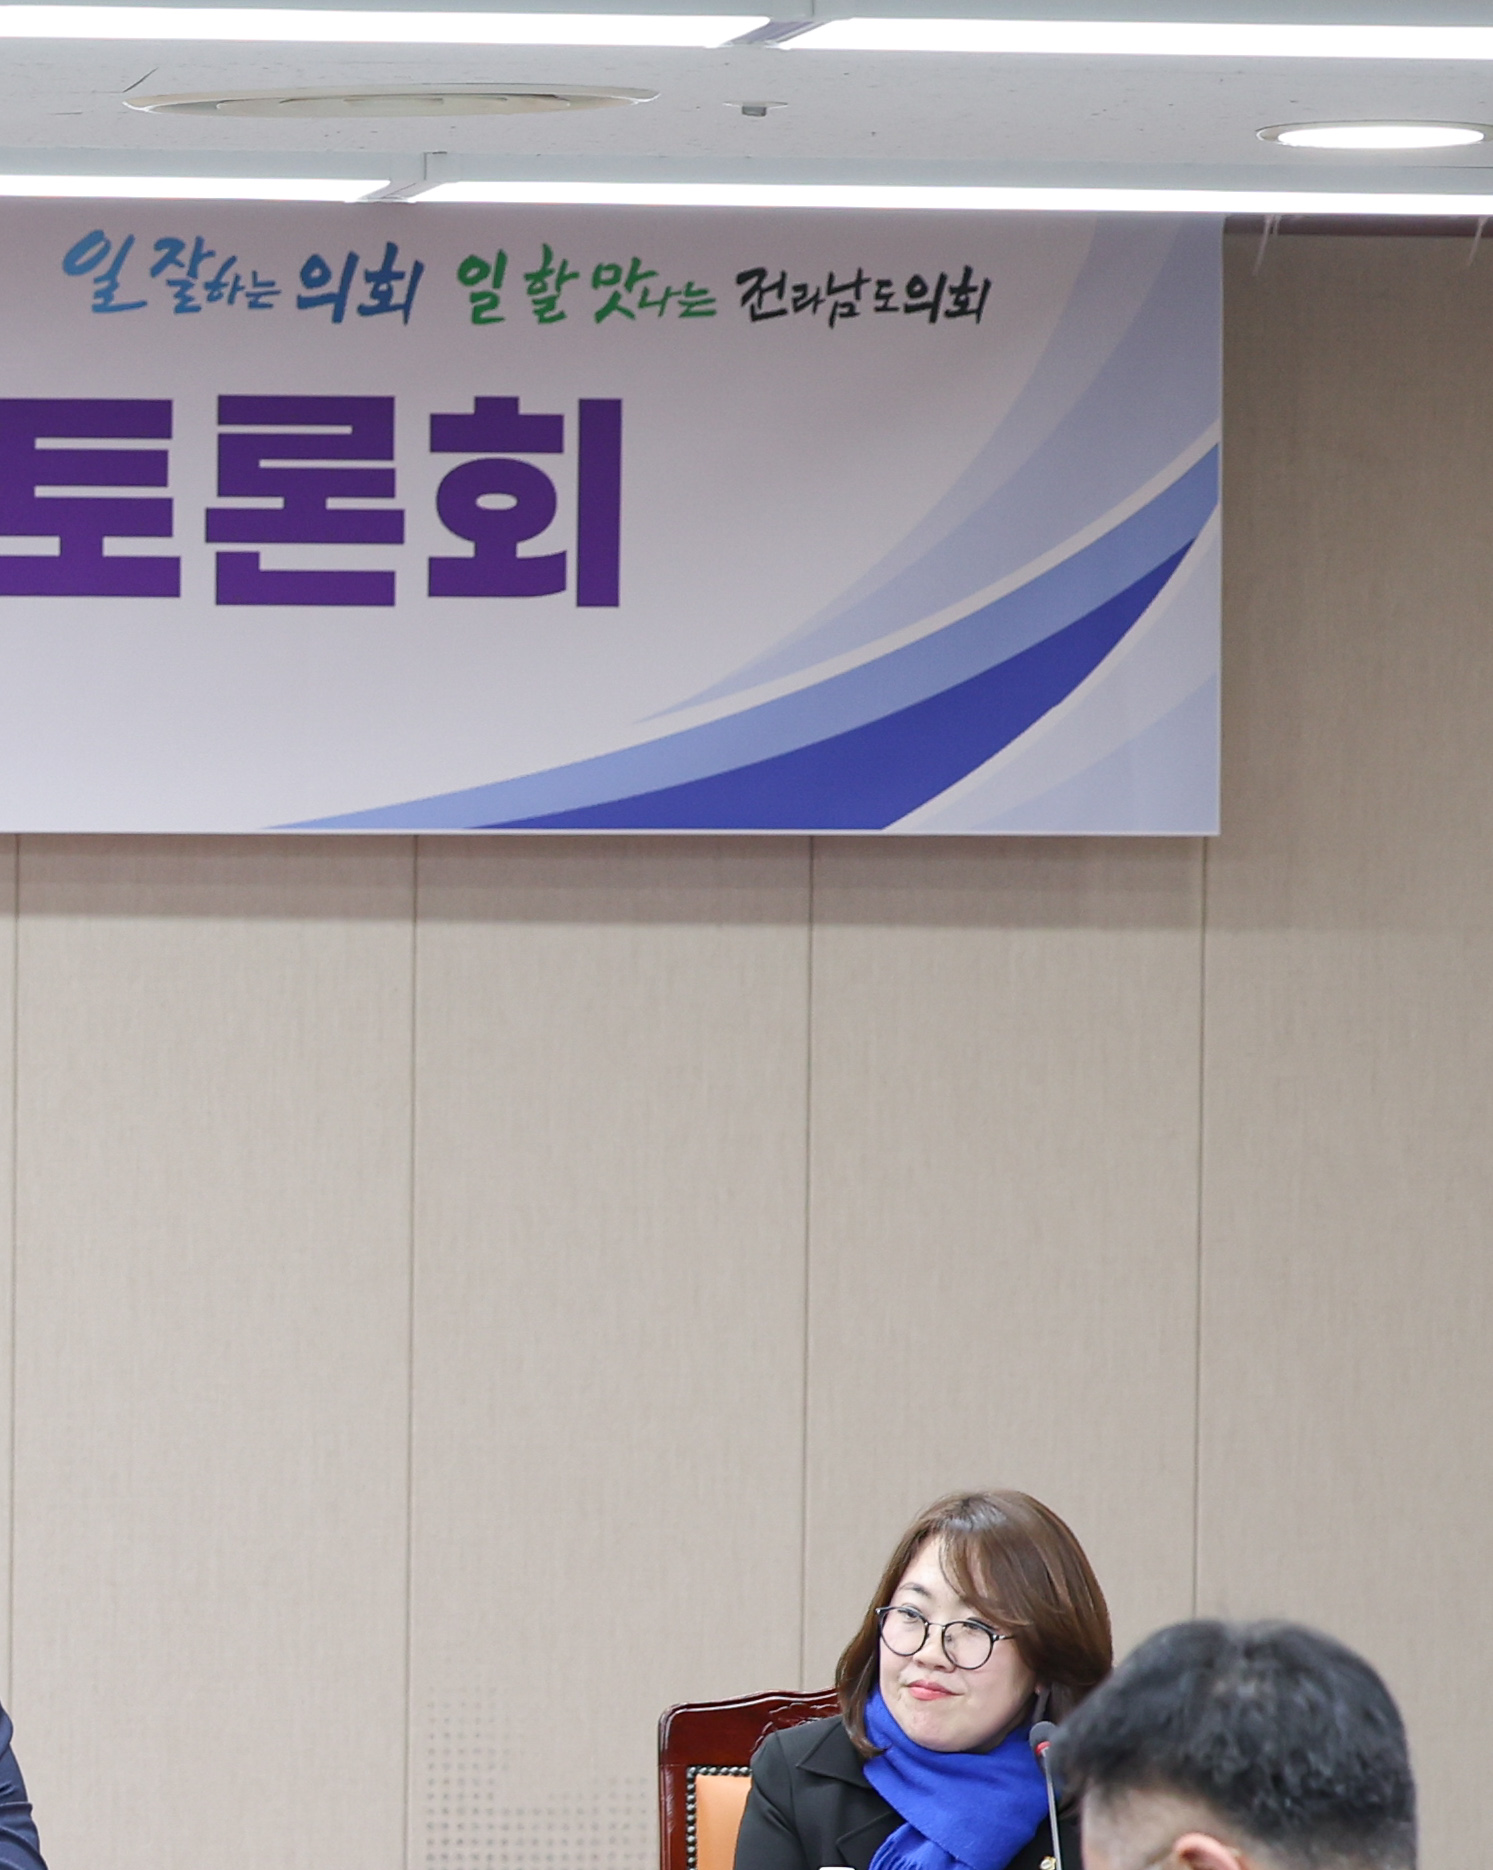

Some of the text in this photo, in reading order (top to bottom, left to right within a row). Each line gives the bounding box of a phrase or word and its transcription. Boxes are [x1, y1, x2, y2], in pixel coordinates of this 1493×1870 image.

[62, 229, 147, 313] 일
[297, 242, 424, 325] 의회
[735, 265, 992, 328] 전라남도의회
